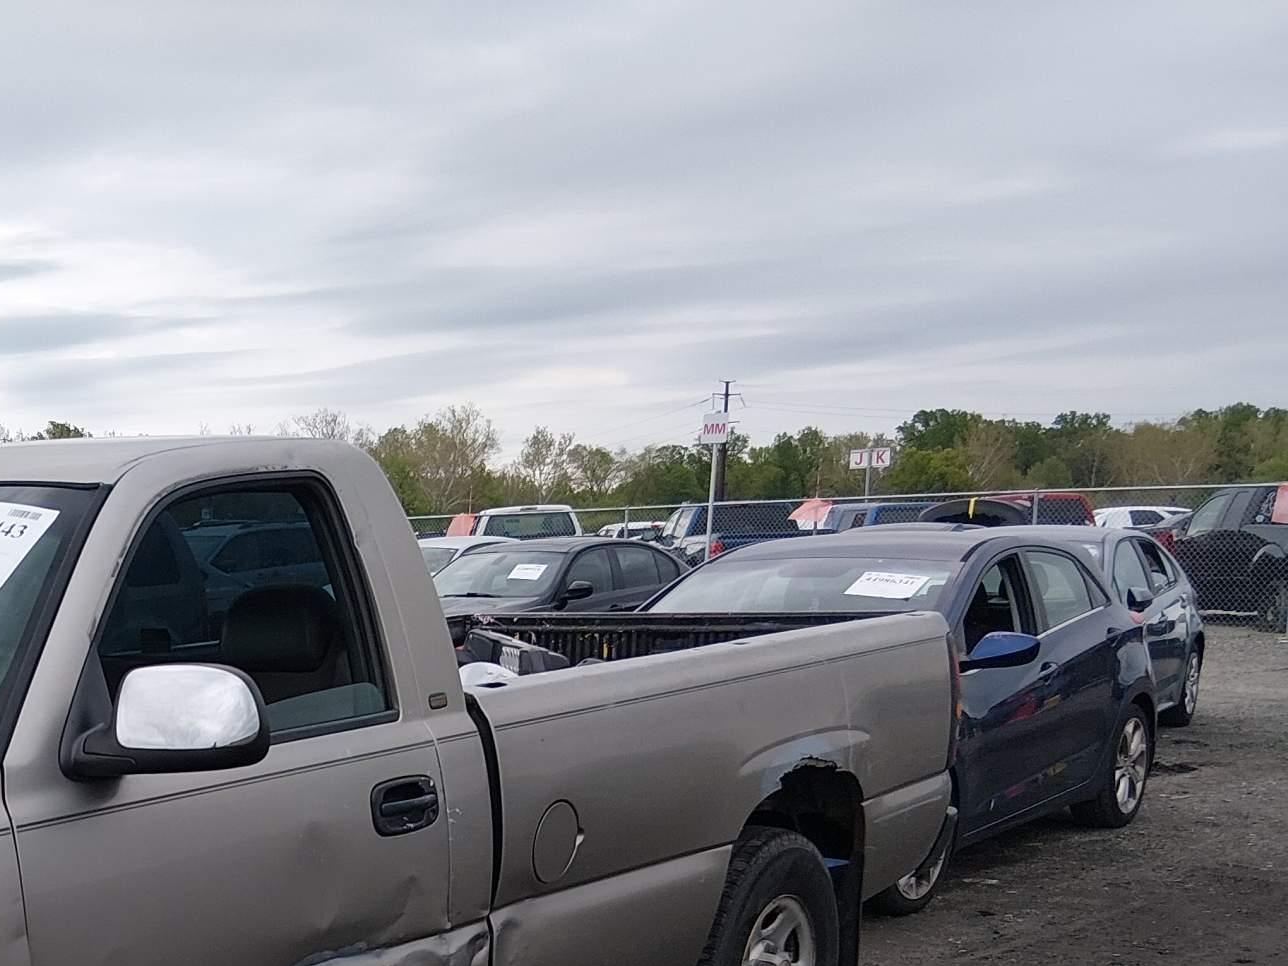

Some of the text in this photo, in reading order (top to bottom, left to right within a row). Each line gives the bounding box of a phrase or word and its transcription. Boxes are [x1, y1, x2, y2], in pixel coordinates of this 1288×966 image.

[703, 423, 726, 435] MM
[855, 452, 863, 465] J
[876, 451, 885, 464] K
